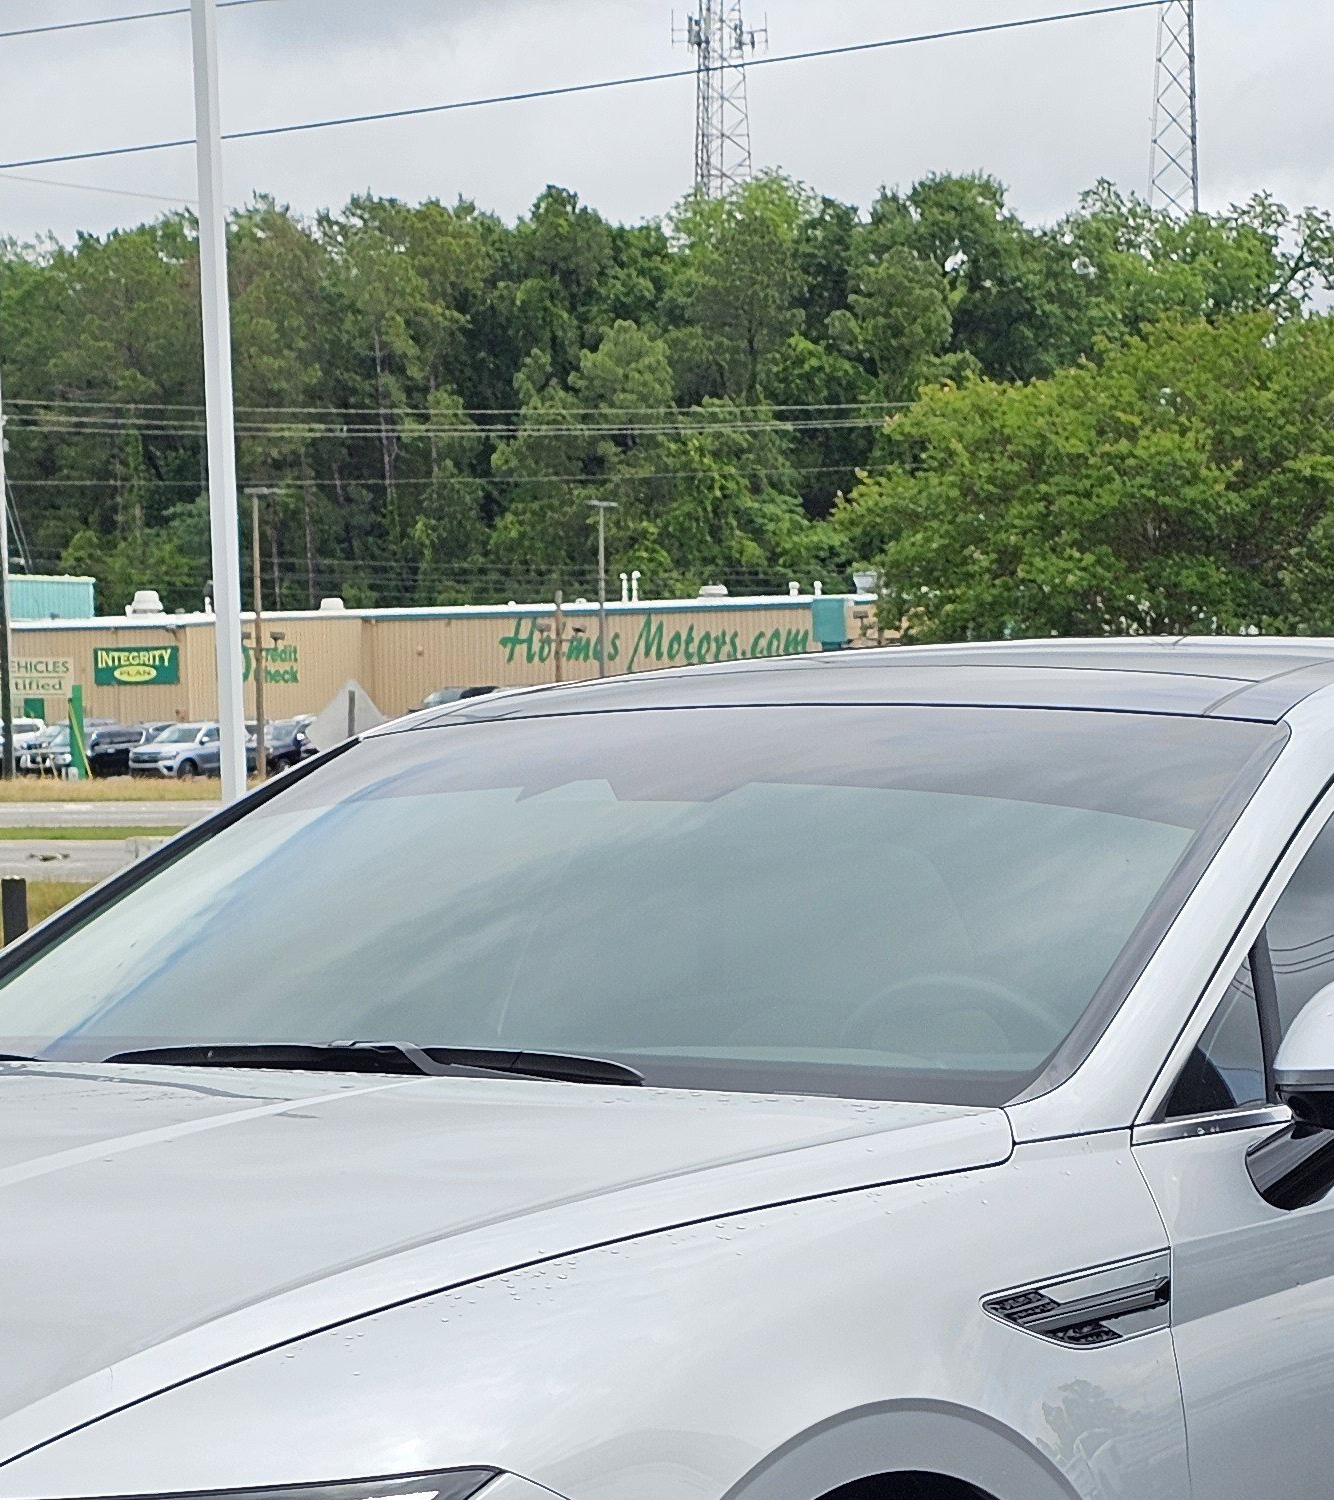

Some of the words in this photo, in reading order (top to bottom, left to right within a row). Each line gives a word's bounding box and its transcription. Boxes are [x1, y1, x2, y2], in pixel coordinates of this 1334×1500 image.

[627, 612, 809, 673] Motors.com
[97, 648, 171, 668] INTEGRITY
[262, 644, 298, 663] redit
[119, 669, 152, 678] PLAN
[262, 664, 299, 684] heck
